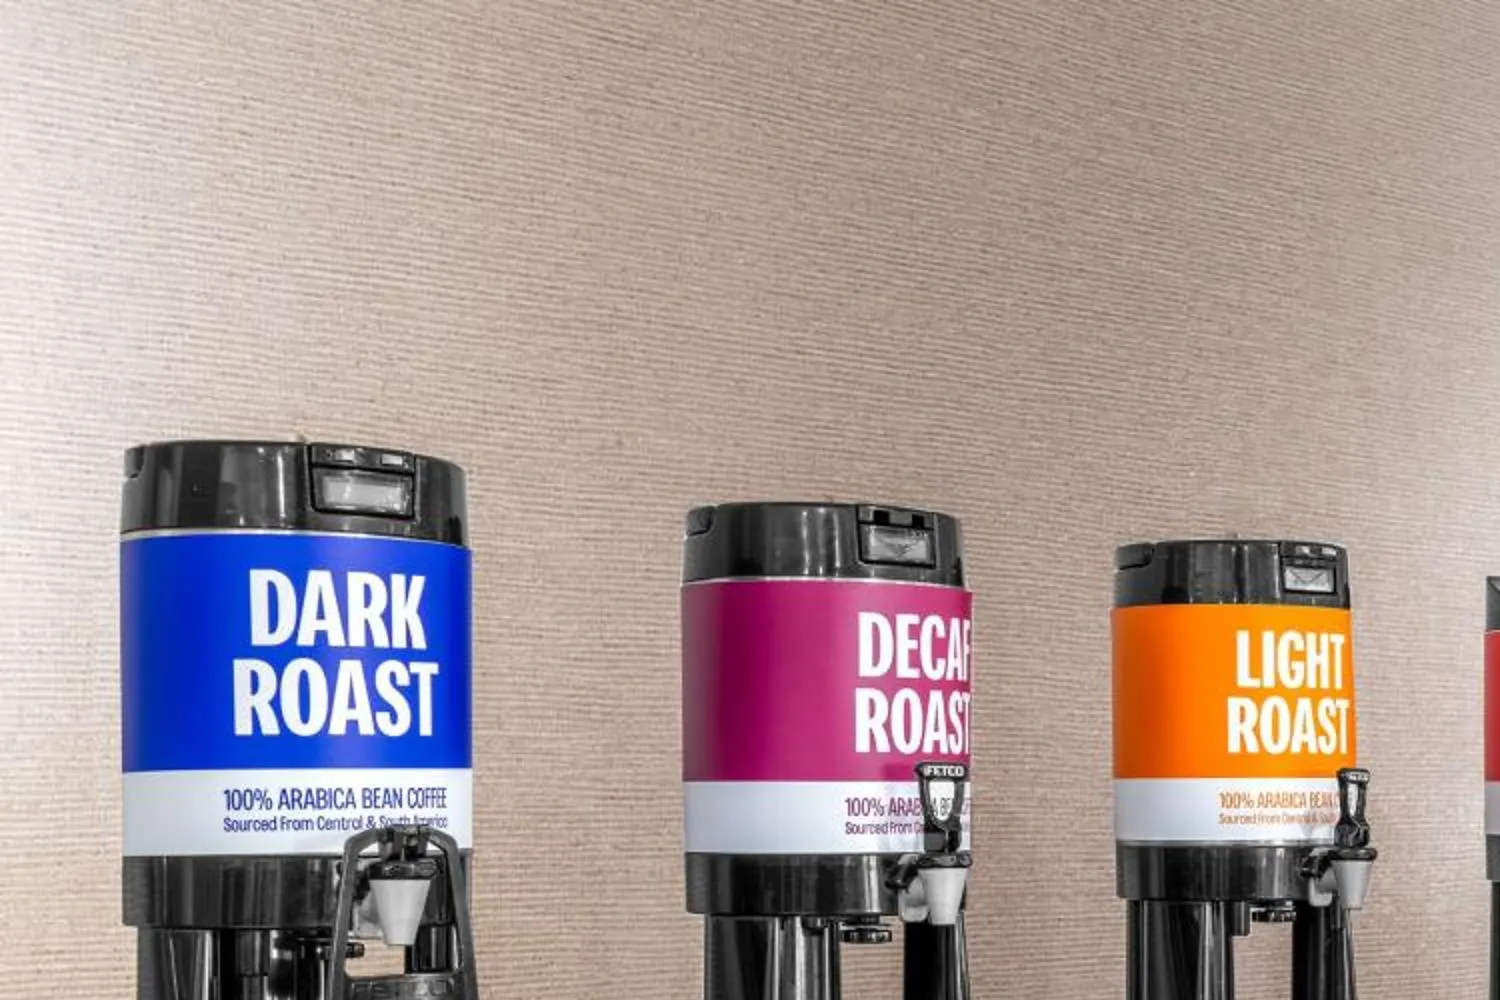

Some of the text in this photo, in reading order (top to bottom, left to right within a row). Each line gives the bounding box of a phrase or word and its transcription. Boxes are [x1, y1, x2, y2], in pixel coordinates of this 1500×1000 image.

[249, 569, 427, 649] DARK
[859, 611, 971, 680] DECAF
[1236, 630, 1345, 690] LIGHT
[233, 657, 439, 737] ROAST
[855, 687, 970, 755] ROAST
[1227, 696, 1350, 754] ROAST
[223, 786, 447, 811] 100% ARABICA BEAN COFFEE
[223, 816, 277, 832] Sourced
[279, 815, 314, 831] From
[317, 815, 363, 831] Central
[366, 815, 376, 829] &
[845, 797, 885, 817] 100%
[1219, 791, 1254, 809] 100%
[1257, 791, 1307, 809] ARABICA
[845, 821, 888, 835] Sourced
